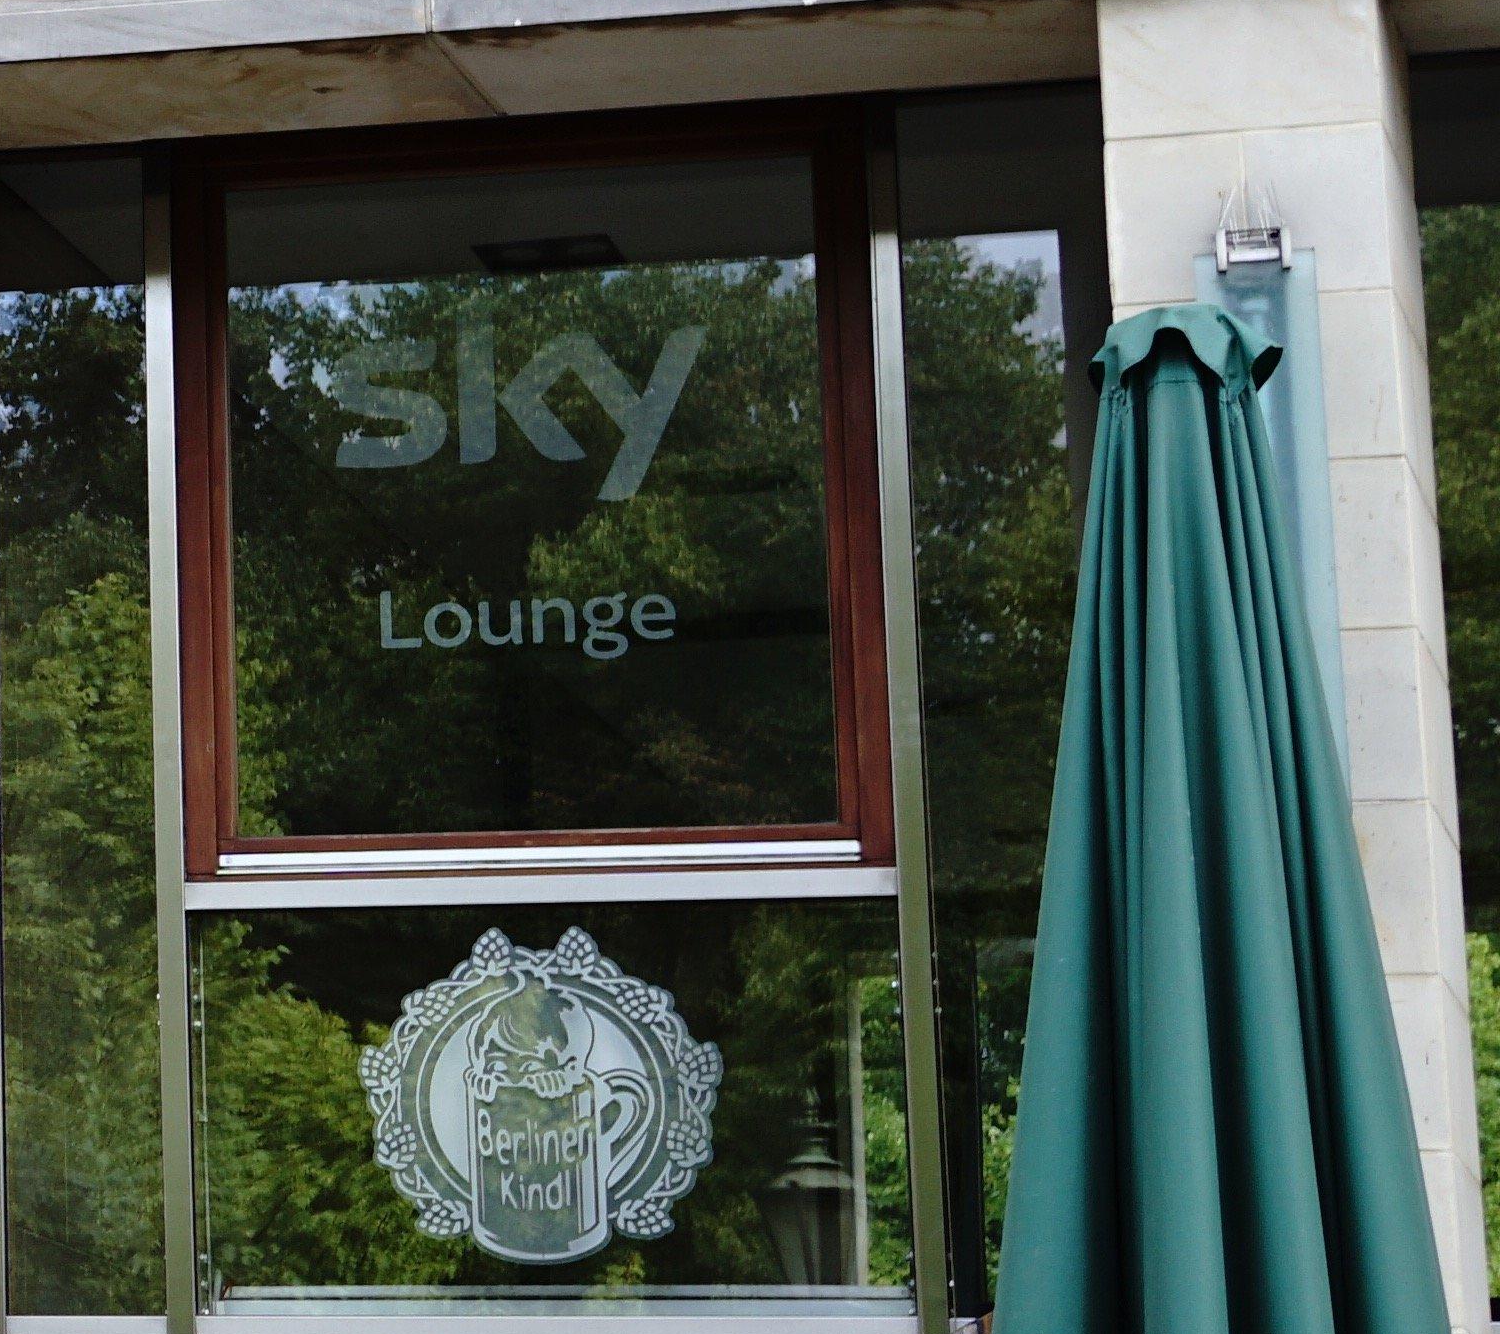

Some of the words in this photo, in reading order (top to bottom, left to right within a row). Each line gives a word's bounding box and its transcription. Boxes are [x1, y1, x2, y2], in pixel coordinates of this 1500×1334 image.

[332, 304, 701, 502] sky
[380, 588, 676, 659] Lounge
[477, 1108, 591, 1166] Berliner
[501, 1169, 571, 1211] Kindl
